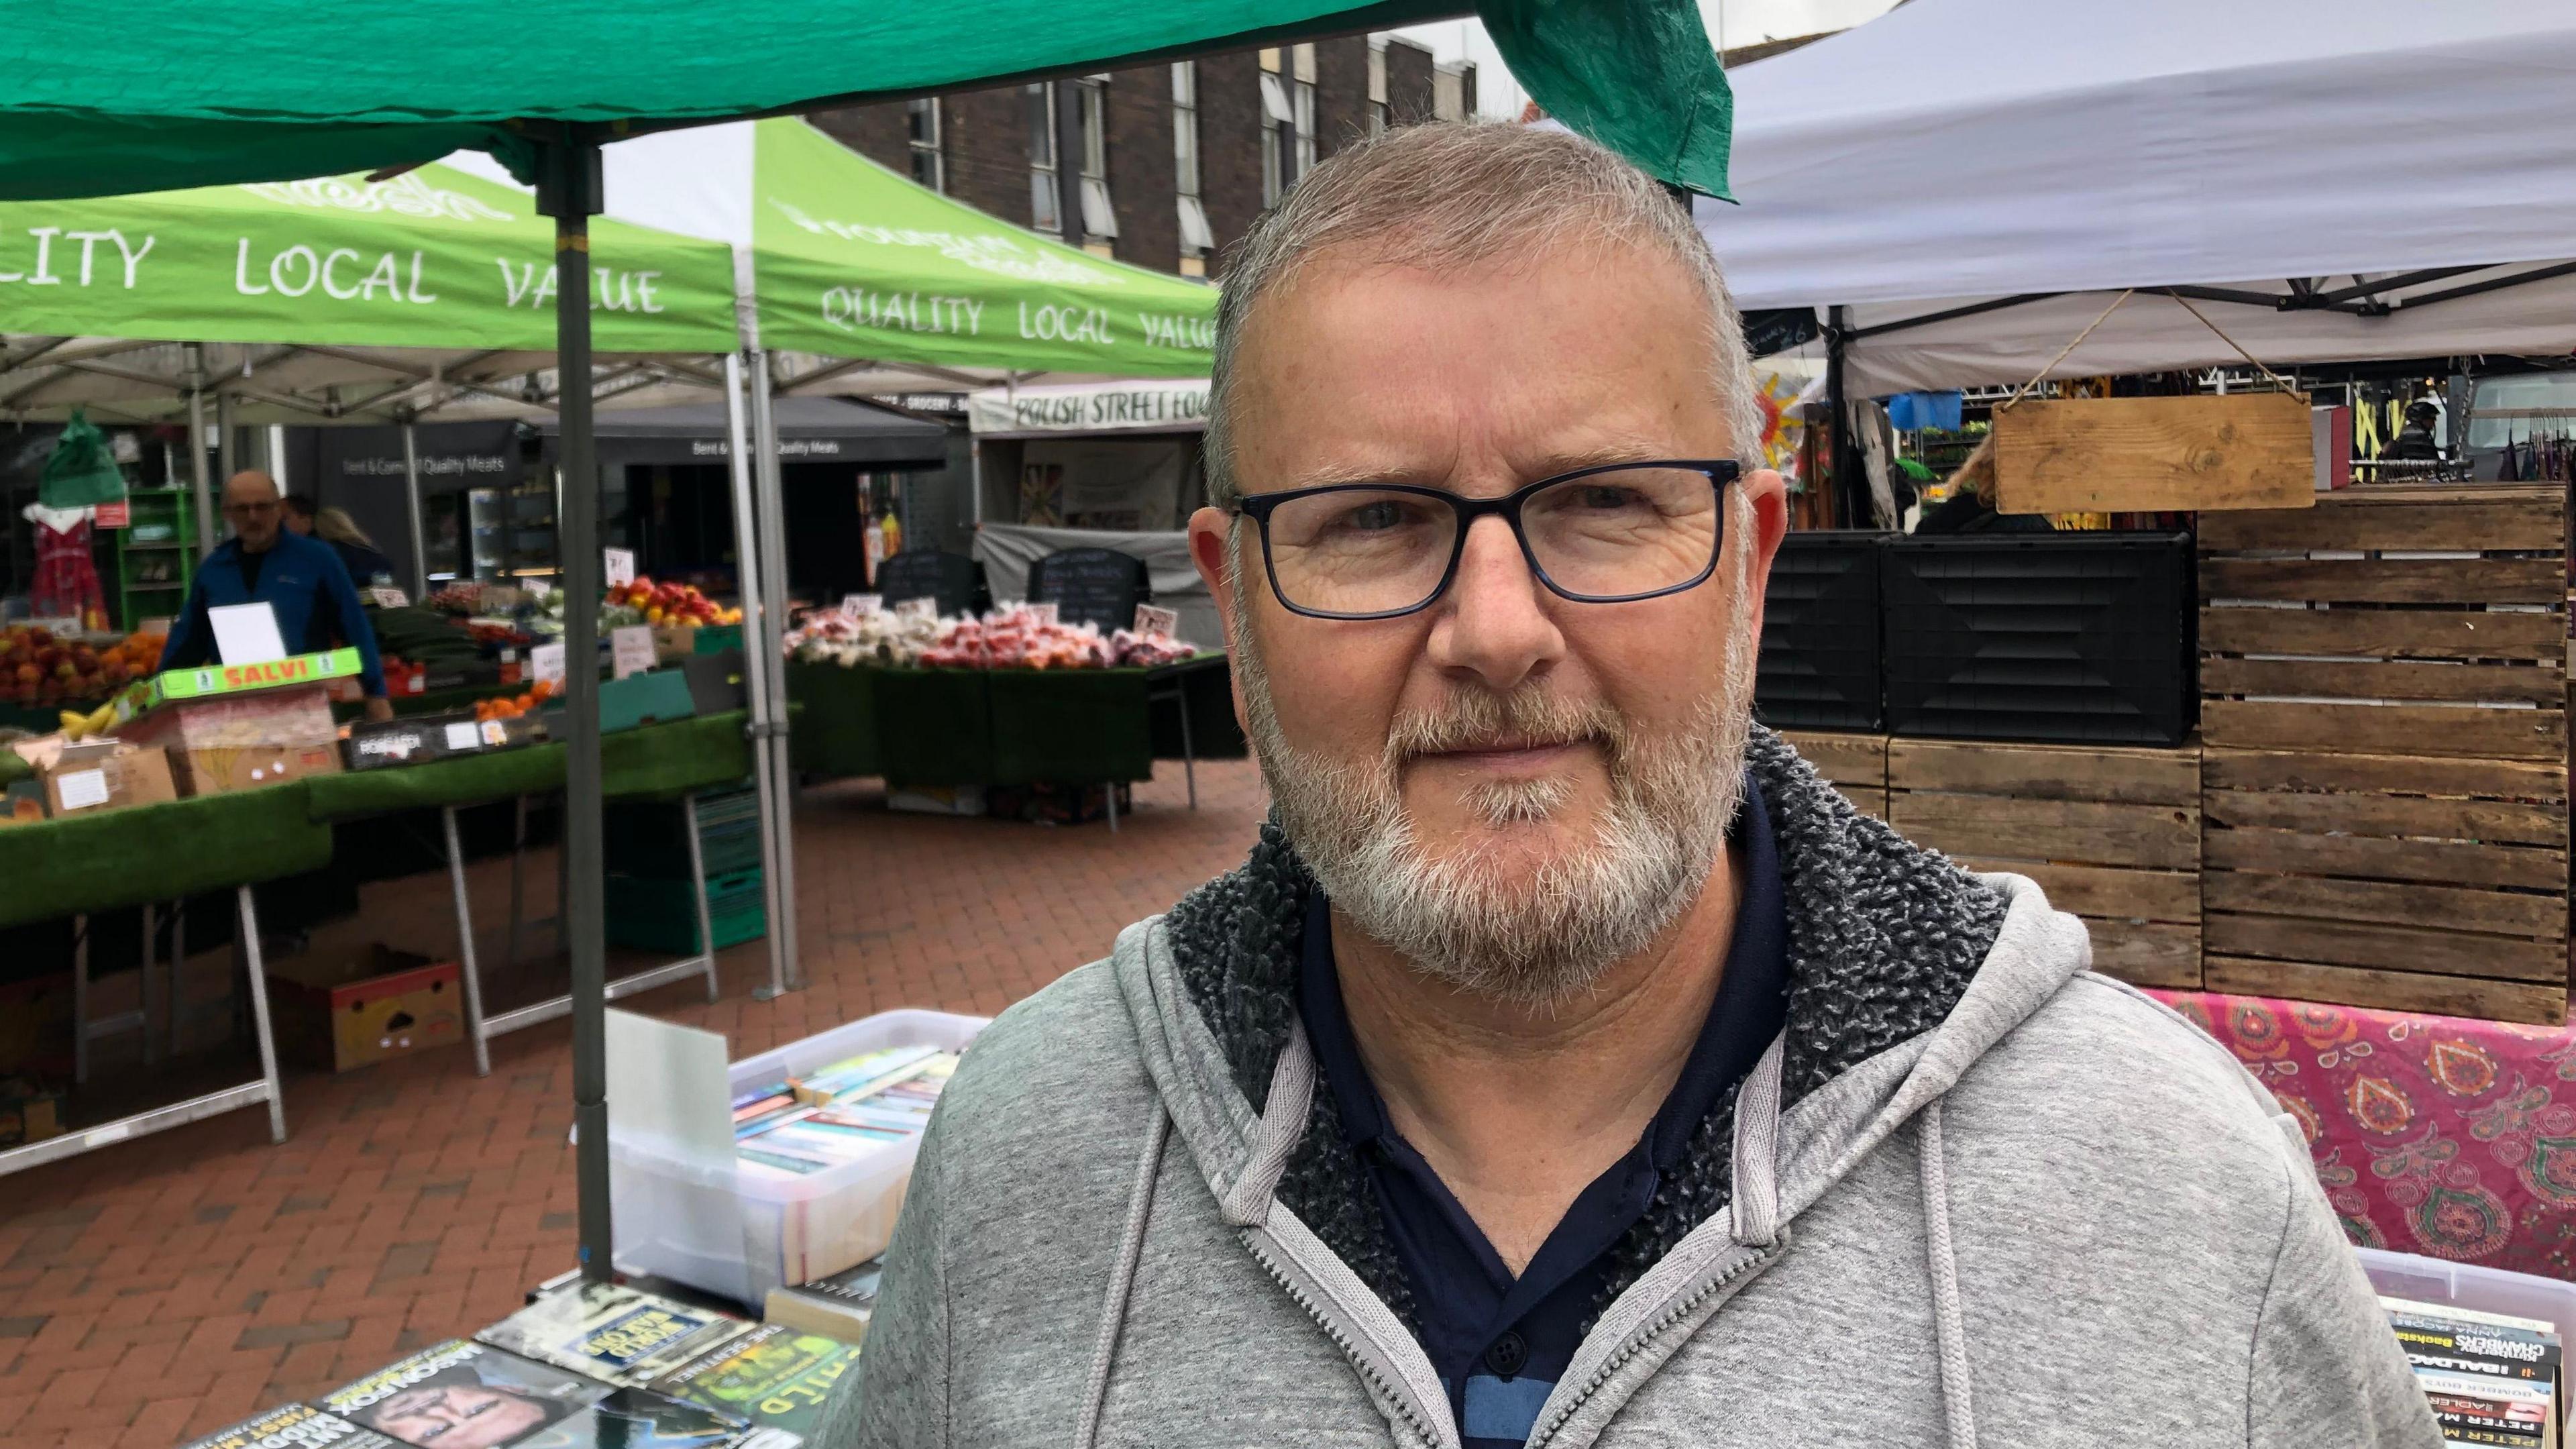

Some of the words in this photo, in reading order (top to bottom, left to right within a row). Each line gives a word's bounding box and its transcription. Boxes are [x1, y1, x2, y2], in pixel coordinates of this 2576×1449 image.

[235, 238, 437, 304] LOCAL
[496, 258, 664, 313] VAUE
[822, 286, 983, 335] QUALITY
[1019, 301, 1114, 343] LOCAL
[1139, 312, 1216, 347] VALU
[1016, 396, 1085, 425] POLISH
[1091, 391, 1168, 423] STREET
[424, 455, 464, 476] Quality
[467, 454, 504, 472] Meats
[224, 660, 309, 688] SALVI
[2396, 1332, 2453, 1348] Backsta
[2455, 1334, 2544, 1357] CHAMBERS
[2408, 1352, 2500, 1375] BALDAC
[2460, 1344, 2538, 1363] Kimberley
[2467, 1381, 2532, 1398] BOMBER
[2430, 1395, 2486, 1411] ADLER
[2467, 1415, 2535, 1431] PETER
[2467, 1431, 2536, 1447] PETER
